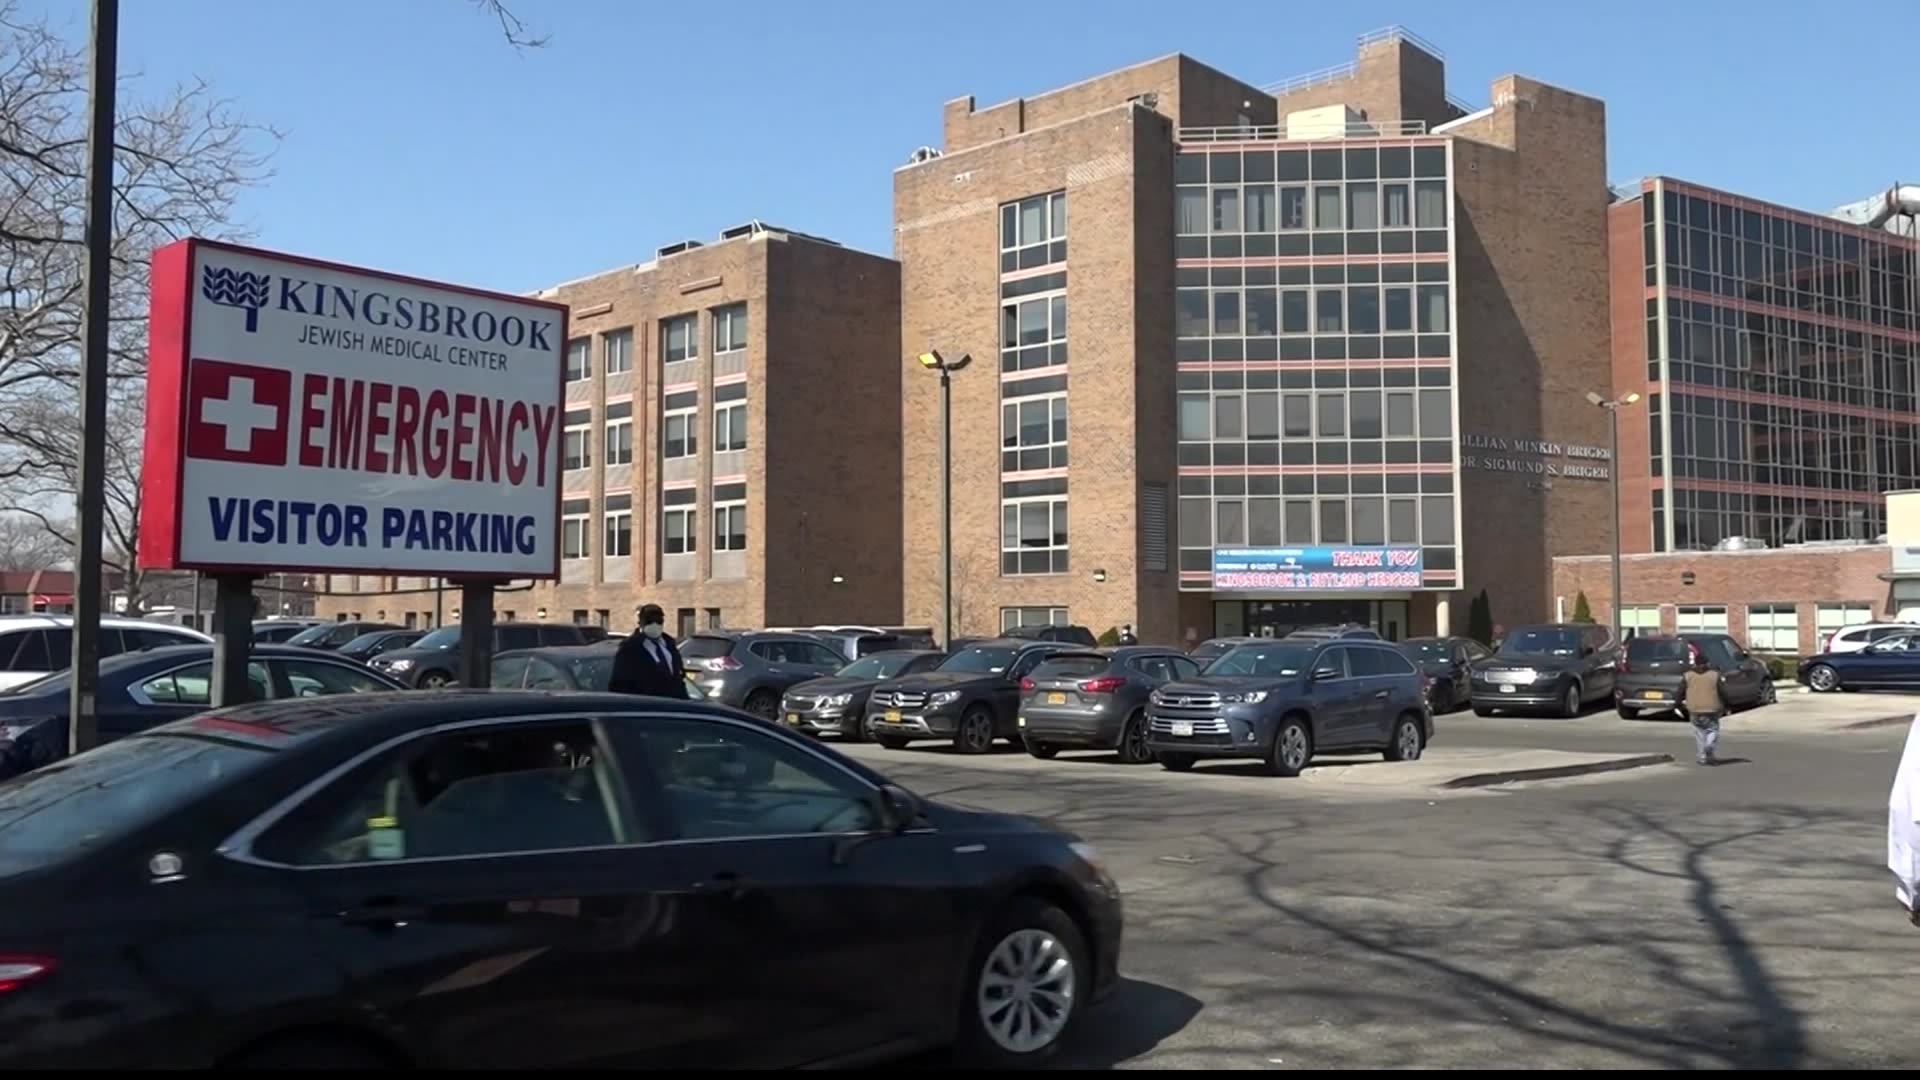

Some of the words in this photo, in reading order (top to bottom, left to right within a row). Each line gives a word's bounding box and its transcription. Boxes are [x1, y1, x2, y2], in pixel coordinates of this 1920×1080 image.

[279, 277, 552, 351] KINGSBROOK
[298, 324, 364, 352] JEWISH
[370, 335, 442, 363] MEDICAL
[448, 346, 508, 371] CENTER
[299, 373, 555, 487] EMERGENCY
[1461, 434, 1507, 449] ILLIAN
[1514, 439, 1562, 455] MINKIN
[1567, 445, 1612, 459] BRIGER
[1484, 457, 1544, 474] SIGMUND
[1563, 464, 1609, 479] BRIGER
[208, 496, 368, 548] VISITOR
[382, 507, 536, 555] PARKING
[1331, 551, 1384, 567] THANK
[1386, 549, 1419, 566] YOU
